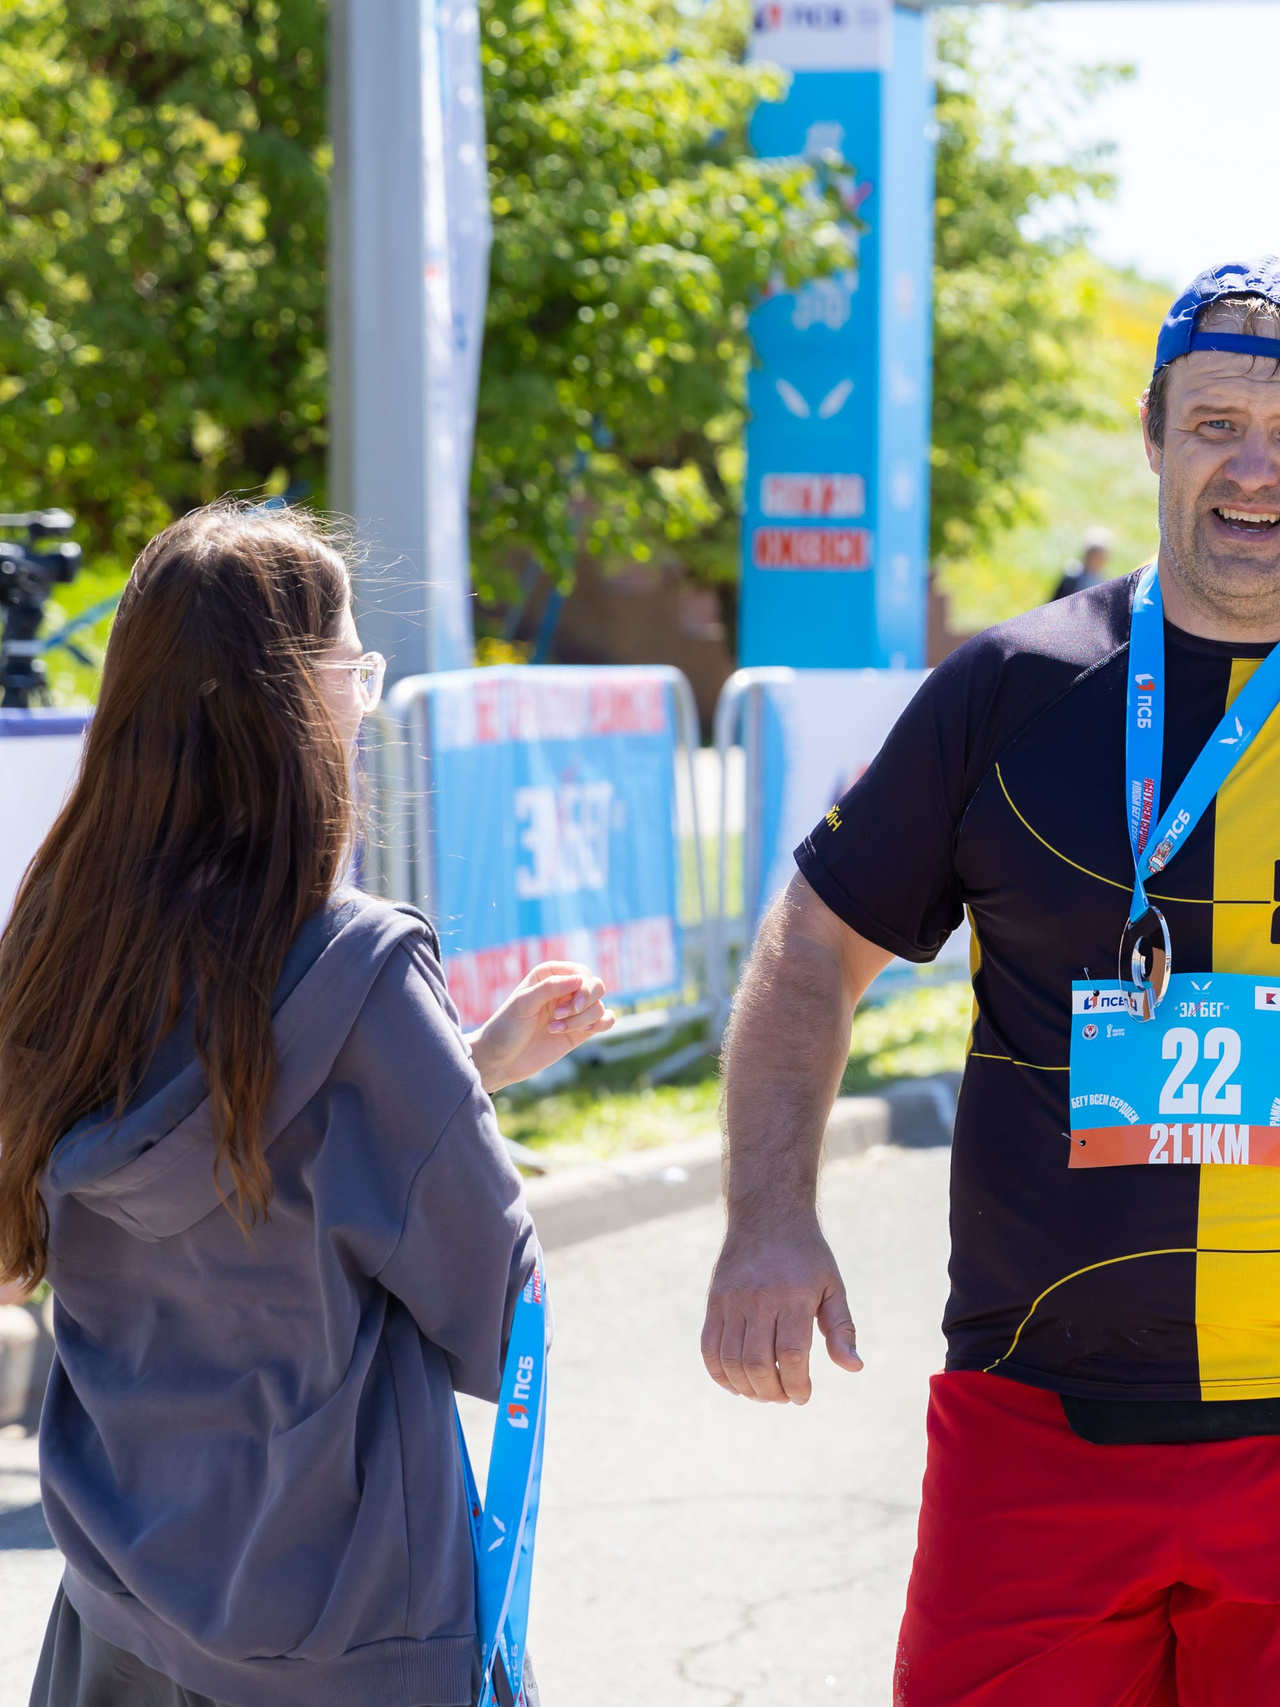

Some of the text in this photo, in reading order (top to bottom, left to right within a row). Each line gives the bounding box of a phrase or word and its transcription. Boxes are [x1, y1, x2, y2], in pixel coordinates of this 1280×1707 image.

[1137, 695, 1152, 729] ПСБ
[1158, 1027, 1241, 1115] 22
[1071, 1094, 1140, 1125] БЕГУ ВСЕМ СЕРДЦЕМ
[513, 1355, 534, 1400] ПСБ
